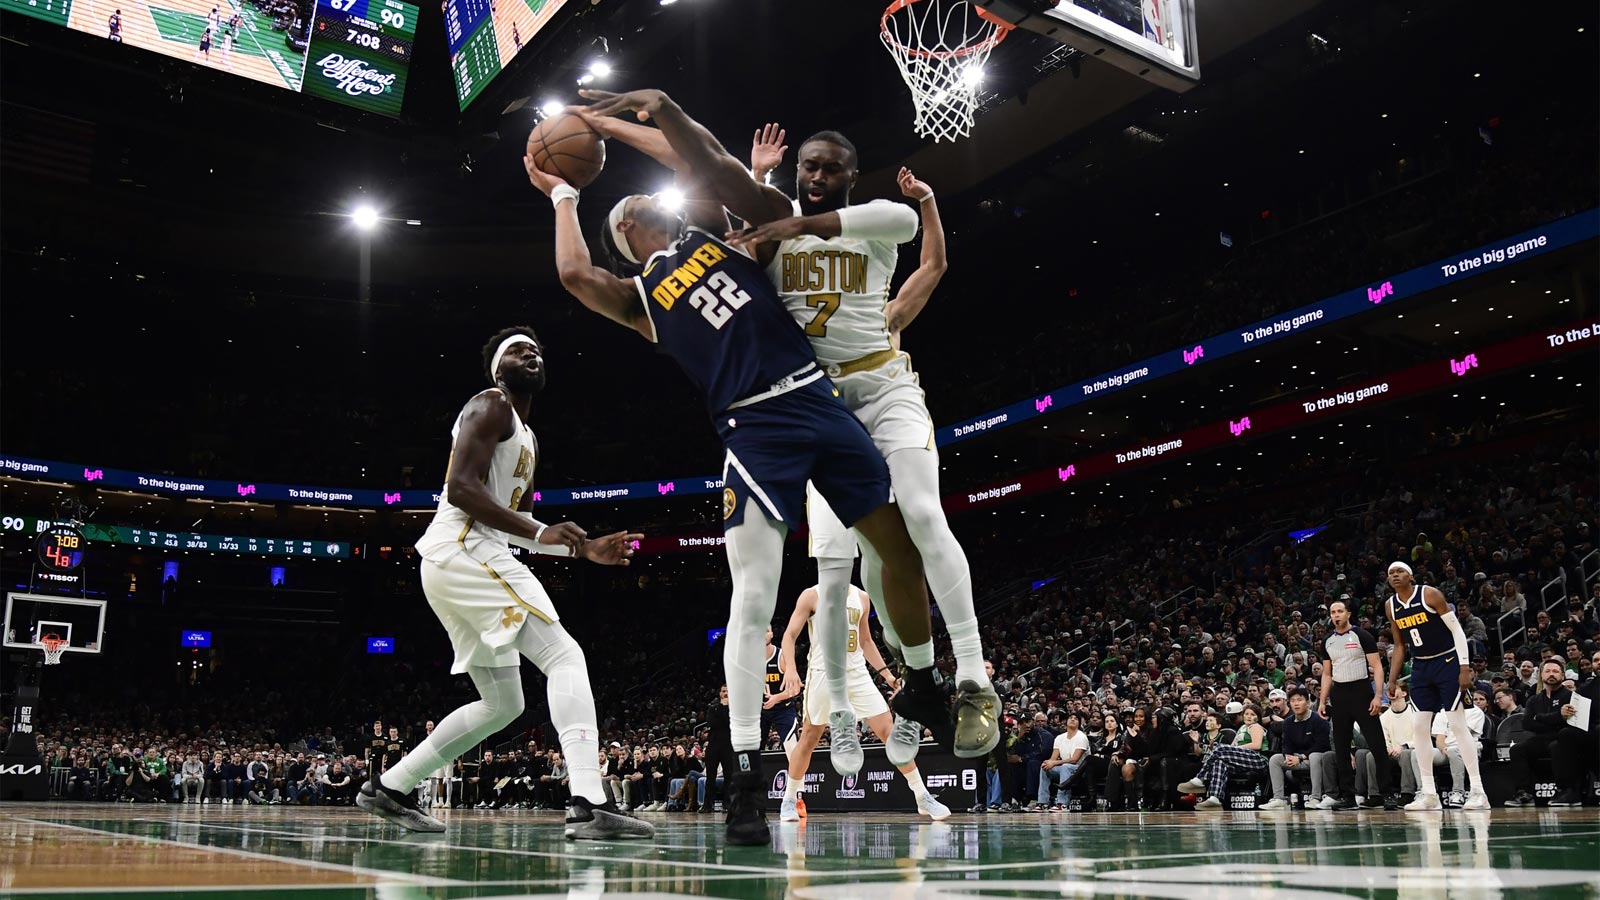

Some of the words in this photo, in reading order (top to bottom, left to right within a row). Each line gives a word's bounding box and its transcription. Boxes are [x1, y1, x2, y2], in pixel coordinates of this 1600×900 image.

[381, 9, 404, 28] 90
[346, 29, 380, 50] 7:08
[392, 44, 404, 54] 4th
[316, 53, 396, 86] Different
[323, 69, 384, 95] Here
[1442, 265, 1457, 278] To
[1459, 257, 1481, 272] the
[1483, 248, 1505, 265] big
[1507, 235, 1547, 259] game
[652, 242, 728, 311] DENVER
[782, 250, 868, 294] BOSTON
[688, 270, 752, 330] 22
[1368, 282, 1393, 304] lyft
[804, 293, 841, 337] 7
[1242, 332, 1254, 343] To
[1255, 327, 1272, 339] the
[1274, 320, 1291, 333] big
[1292, 310, 1323, 328] game
[1547, 334, 1565, 347] To
[1566, 326, 1590, 342] the
[1183, 345, 1204, 364] lyft
[1450, 354, 1478, 376] lyft
[1083, 385, 1092, 395] To
[1094, 380, 1108, 391] the
[1109, 376, 1122, 386] big
[1123, 368, 1148, 384] game
[1036, 395, 1052, 412] lyft
[1303, 402, 1316, 414] To
[1318, 397, 1336, 410] the
[1337, 392, 1354, 406] big
[1356, 383, 1388, 402] game
[954, 428, 962, 437] To
[963, 425, 974, 434] the
[975, 420, 986, 431] big
[987, 413, 1007, 428] game
[1230, 416, 1251, 436] lyft
[1116, 453, 1126, 464] To
[1127, 450, 1141, 461] the
[1142, 446, 1156, 458] big
[1157, 439, 1182, 454] game
[6, 460, 20, 470] big
[22, 463, 48, 472] game
[84, 468, 103, 481] lyft
[1058, 464, 1075, 481] lyft
[138, 477, 148, 485] To
[150, 479, 164, 487] the
[165, 480, 178, 490] big
[180, 483, 204, 491] game
[238, 484, 255, 496] lyft
[658, 482, 674, 495] lyft
[715, 479, 724, 488] th
[315, 491, 328, 500] big
[384, 493, 401, 504] lyft
[594, 490, 606, 498] big
[607, 489, 628, 498] game
[968, 494, 976, 503] To
[977, 491, 988, 501] the
[989, 487, 1000, 498] big
[1001, 483, 1021, 496] game
[2, 516, 24, 531] 90
[54, 536, 78, 548] 7:08
[703, 537, 715, 545] big
[46, 546, 69, 567] 4.8
[1395, 612, 1429, 629] DENVER
[1410, 628, 1423, 647] 8
[21, 706, 32, 714] GET
[21, 715, 31, 723] THE
[819, 773, 824, 781] 12
[867, 771, 894, 781] JANUARY
[927, 775, 957, 787] ESPN
[813, 784, 819, 793] ET
[873, 783, 888, 792] 17-18
